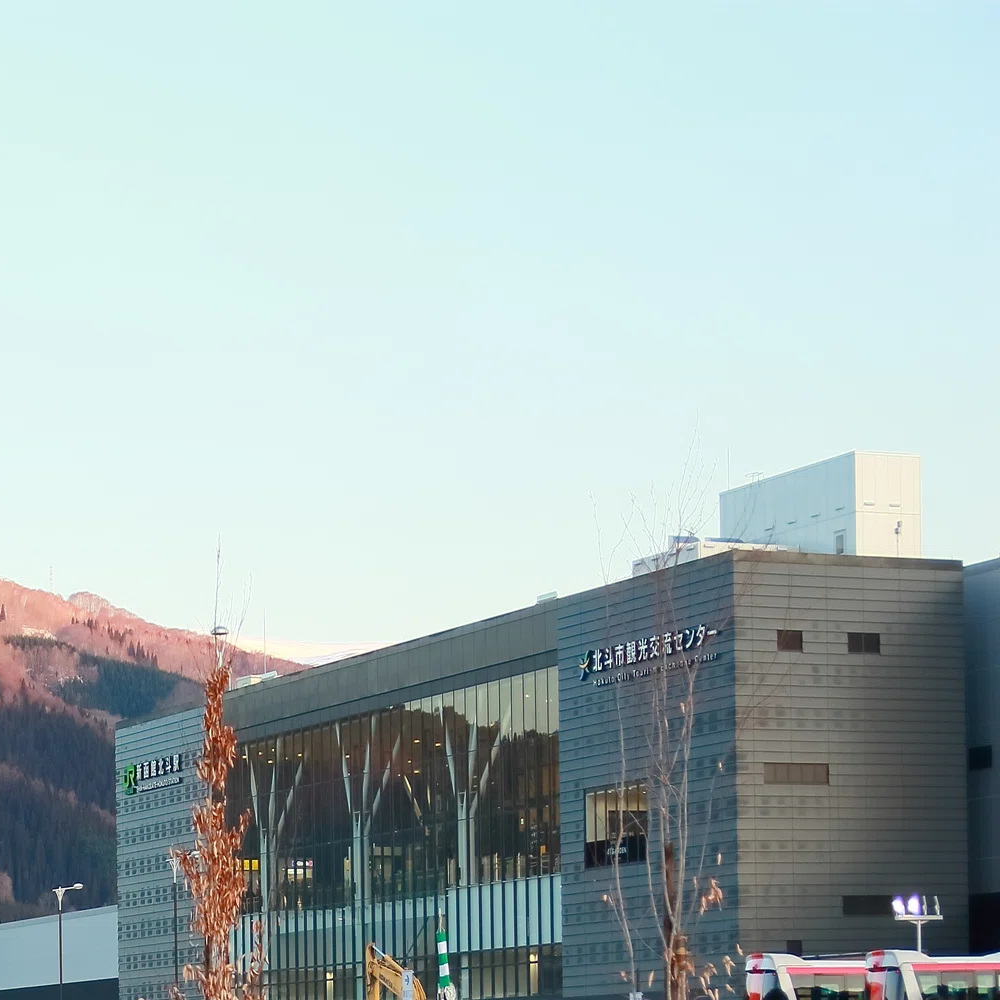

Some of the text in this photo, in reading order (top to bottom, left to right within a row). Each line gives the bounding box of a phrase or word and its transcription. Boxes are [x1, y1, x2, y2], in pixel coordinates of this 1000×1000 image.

[593, 624, 717, 671] 北斗市観光交流センター
[123, 764, 135, 789] JR
